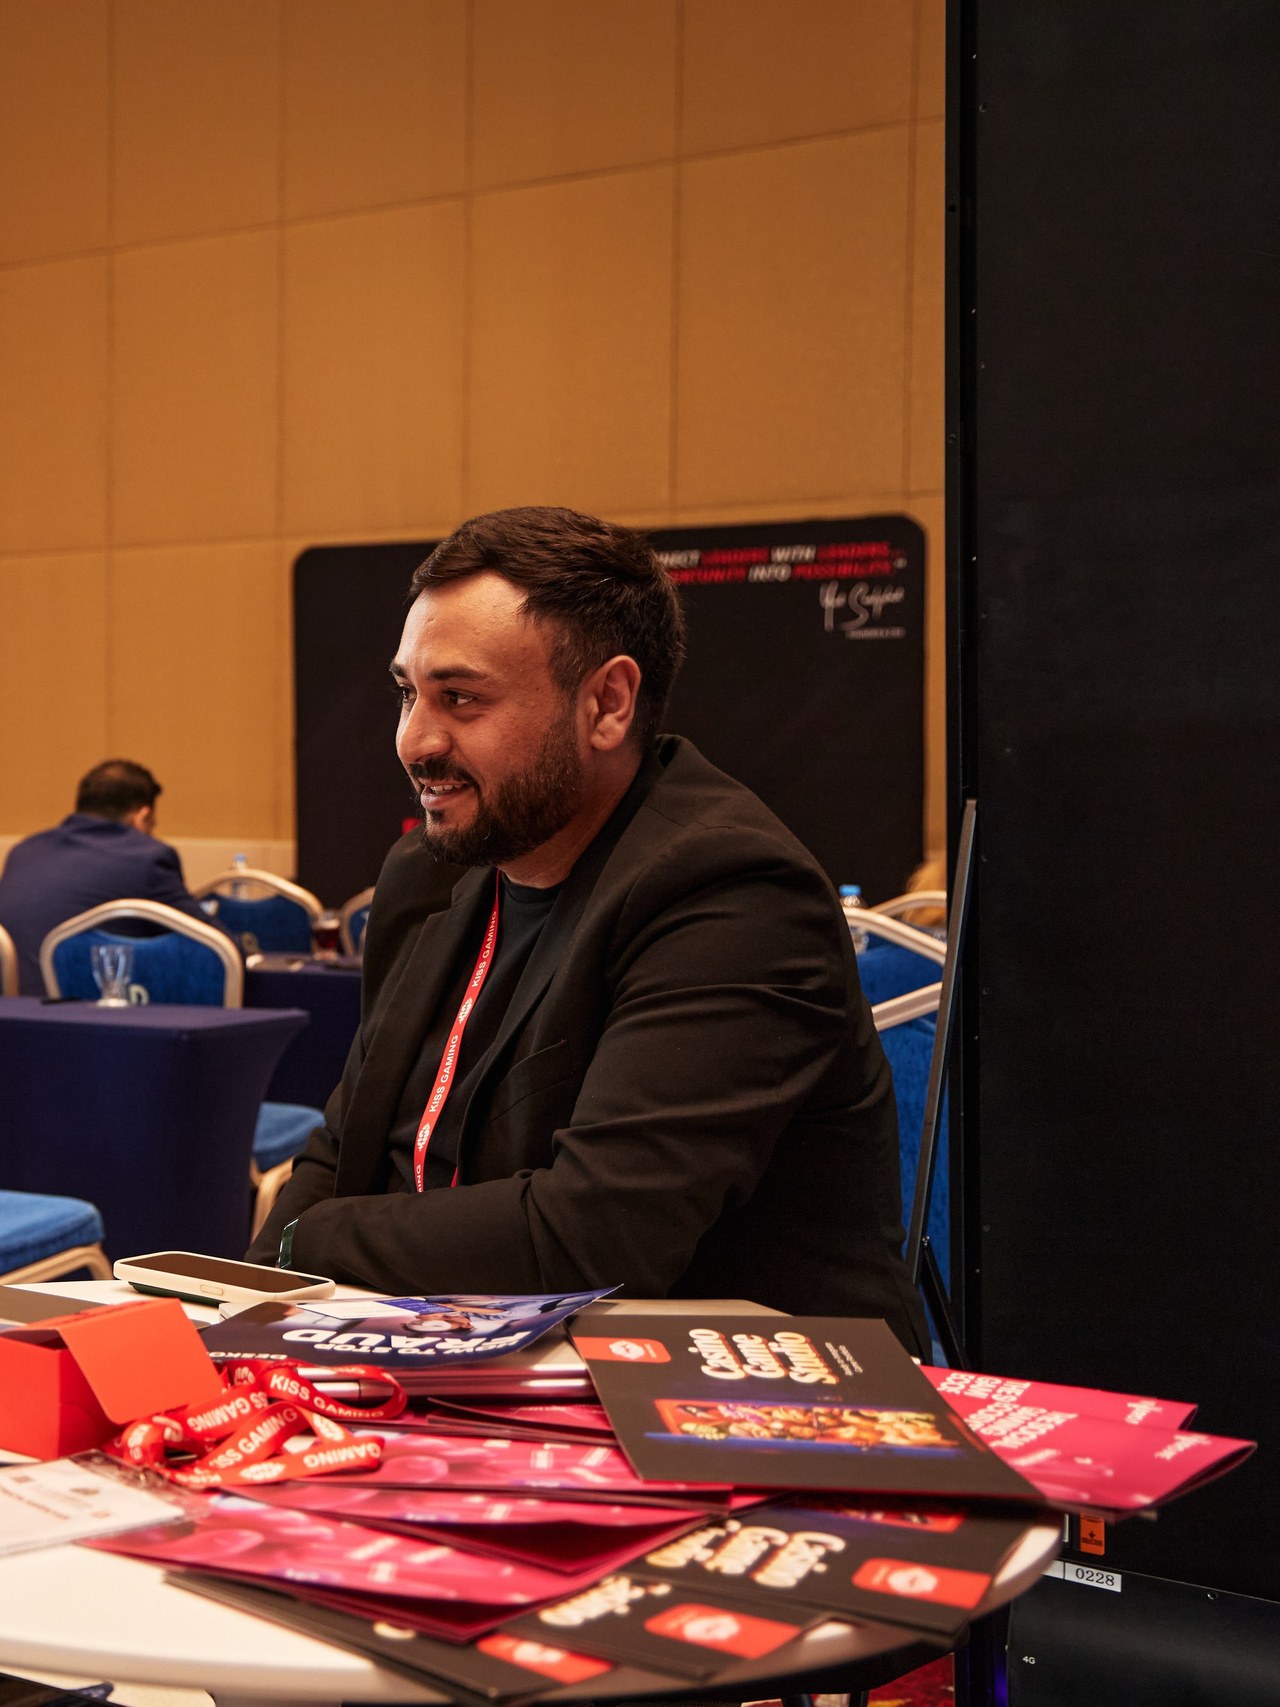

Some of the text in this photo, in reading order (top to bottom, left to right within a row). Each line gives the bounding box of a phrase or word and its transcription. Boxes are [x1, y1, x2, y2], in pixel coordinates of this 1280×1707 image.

[471, 910, 497, 987] KISS GAMING
[428, 1034, 459, 1113] KISS GAMING
[282, 1328, 533, 1350] FRAUD
[314, 1343, 393, 1355] STOP
[687, 1328, 748, 1381] Casino
[731, 1333, 788, 1380] Game
[767, 1331, 839, 1386] Studio
[186, 1396, 251, 1432] GAMING
[269, 1373, 385, 1418] KISS GAMING
[237, 1407, 298, 1454] GAMING
[302, 1442, 381, 1469] GAMING
[1074, 1567, 1115, 1588] 0228
